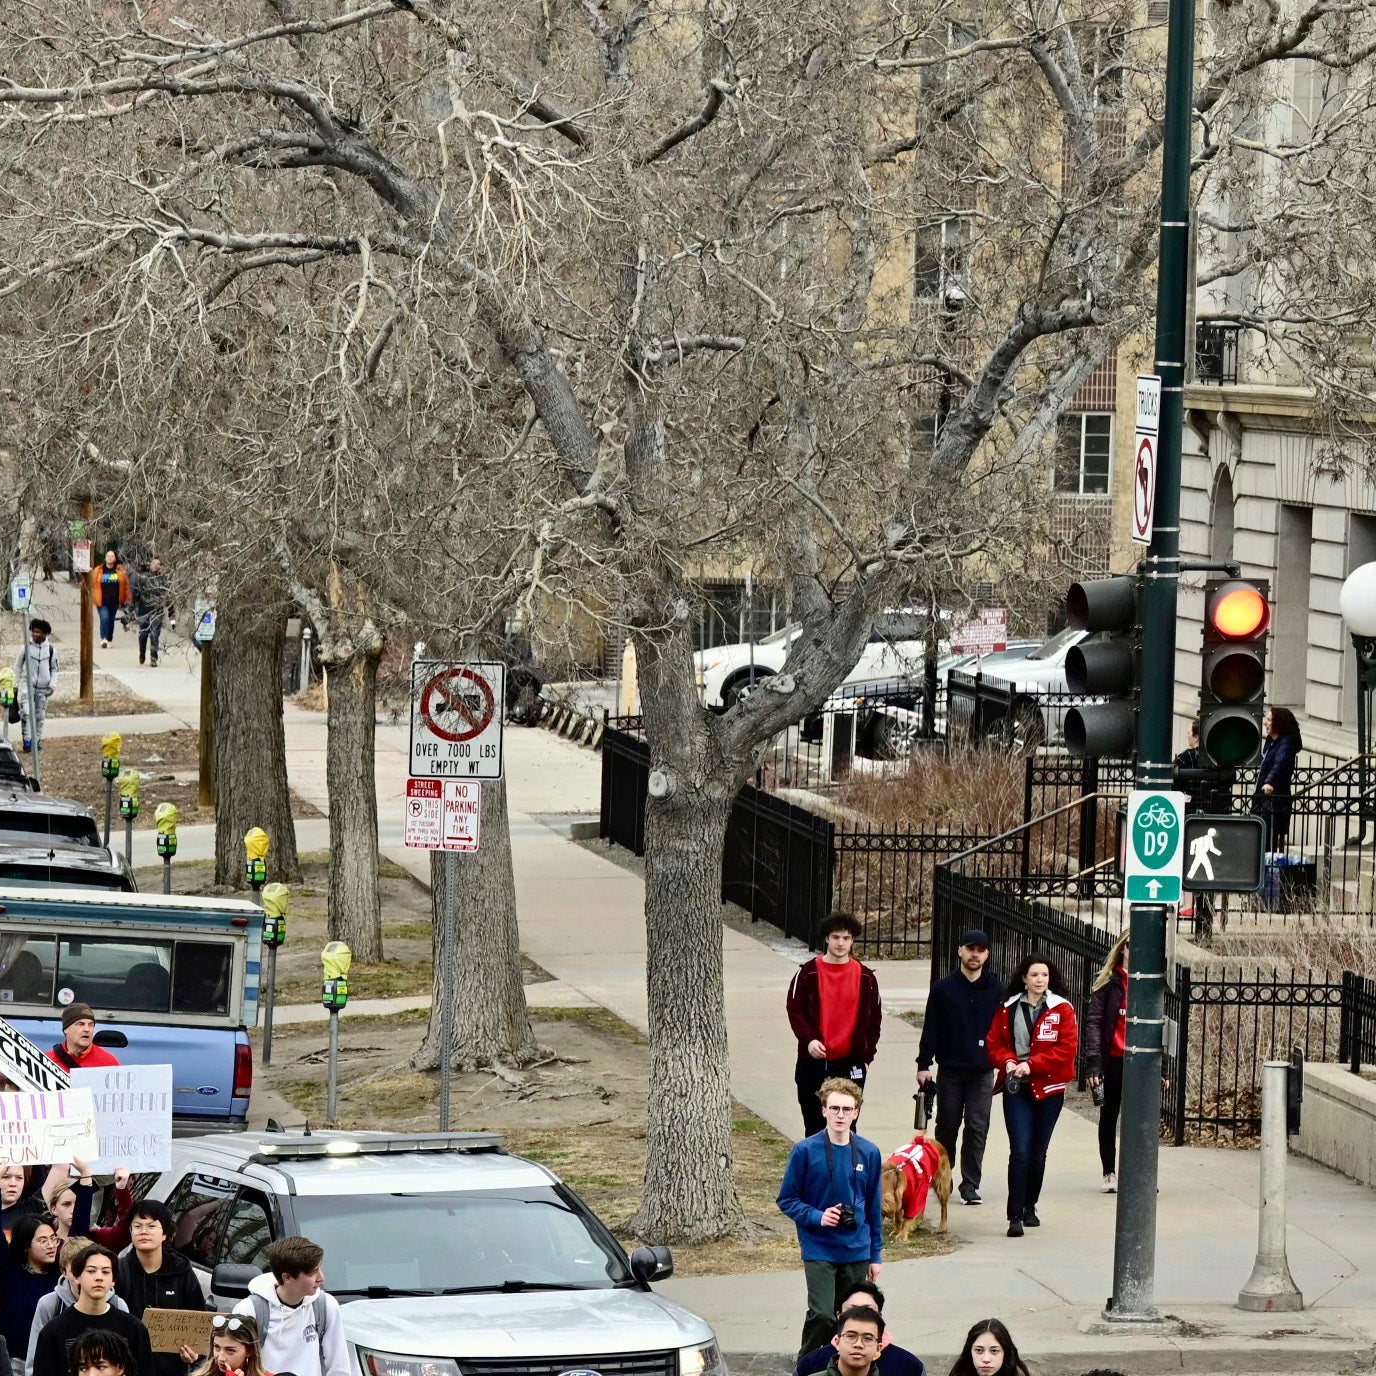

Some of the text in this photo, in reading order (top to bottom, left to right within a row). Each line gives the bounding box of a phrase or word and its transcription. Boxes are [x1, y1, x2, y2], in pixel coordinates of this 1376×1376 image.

[1138, 389, 1158, 425] TRUCKS
[416, 743, 496, 758] OVER 7000 LBS
[431, 761, 480, 775] EMPTY WT
[414, 781, 434, 790] STREET
[411, 788, 438, 797] SWEEPING
[455, 785, 468, 798] NO
[425, 800, 438, 809] THIS
[446, 800, 477, 814] PARKING
[424, 809, 438, 818] SIDE
[454, 815, 467, 824] ANY
[452, 825, 469, 834] TIME
[1142, 832, 1170, 857] D9
[200, 1086, 216, 1094] Ford
